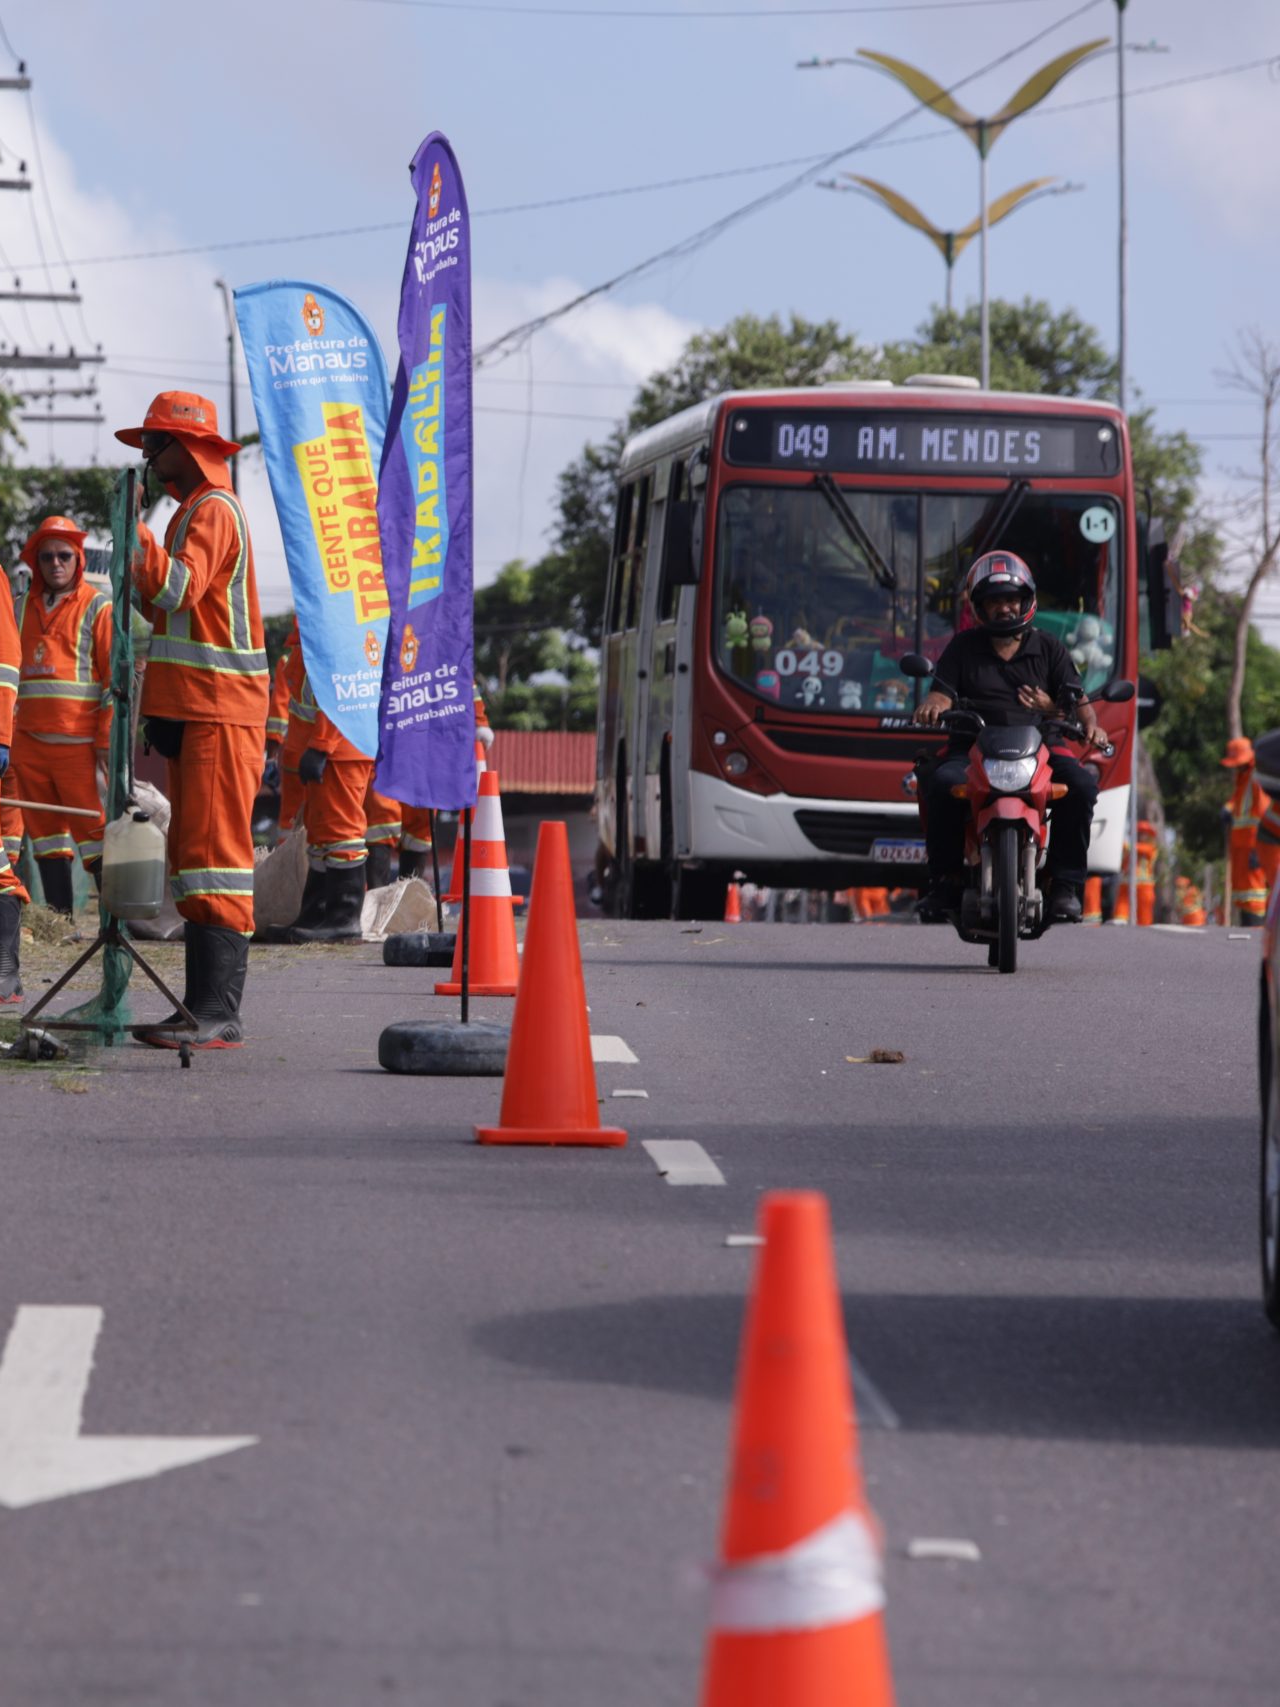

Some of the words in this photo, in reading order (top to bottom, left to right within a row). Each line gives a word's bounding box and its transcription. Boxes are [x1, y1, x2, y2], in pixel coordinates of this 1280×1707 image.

[449, 207, 461, 224] de
[264, 337, 345, 357] Prefeitura
[347, 335, 369, 348] de
[269, 351, 368, 377] Manaus
[273, 378, 308, 390] Gente
[309, 375, 328, 386] que
[330, 373, 369, 383] trabalha
[778, 423, 829, 459] 049
[857, 426, 905, 461] AM.
[921, 427, 1041, 465] MENDES
[305, 443, 334, 497] QUE
[326, 409, 390, 617] TRABALHA
[317, 504, 352, 589] GENTE
[775, 649, 844, 677] 049
[392, 672, 432, 692] eitura
[435, 663, 459, 678] de
[386, 680, 459, 715] anaus
[397, 717, 414, 730] que
[415, 704, 466, 722] trabalha
